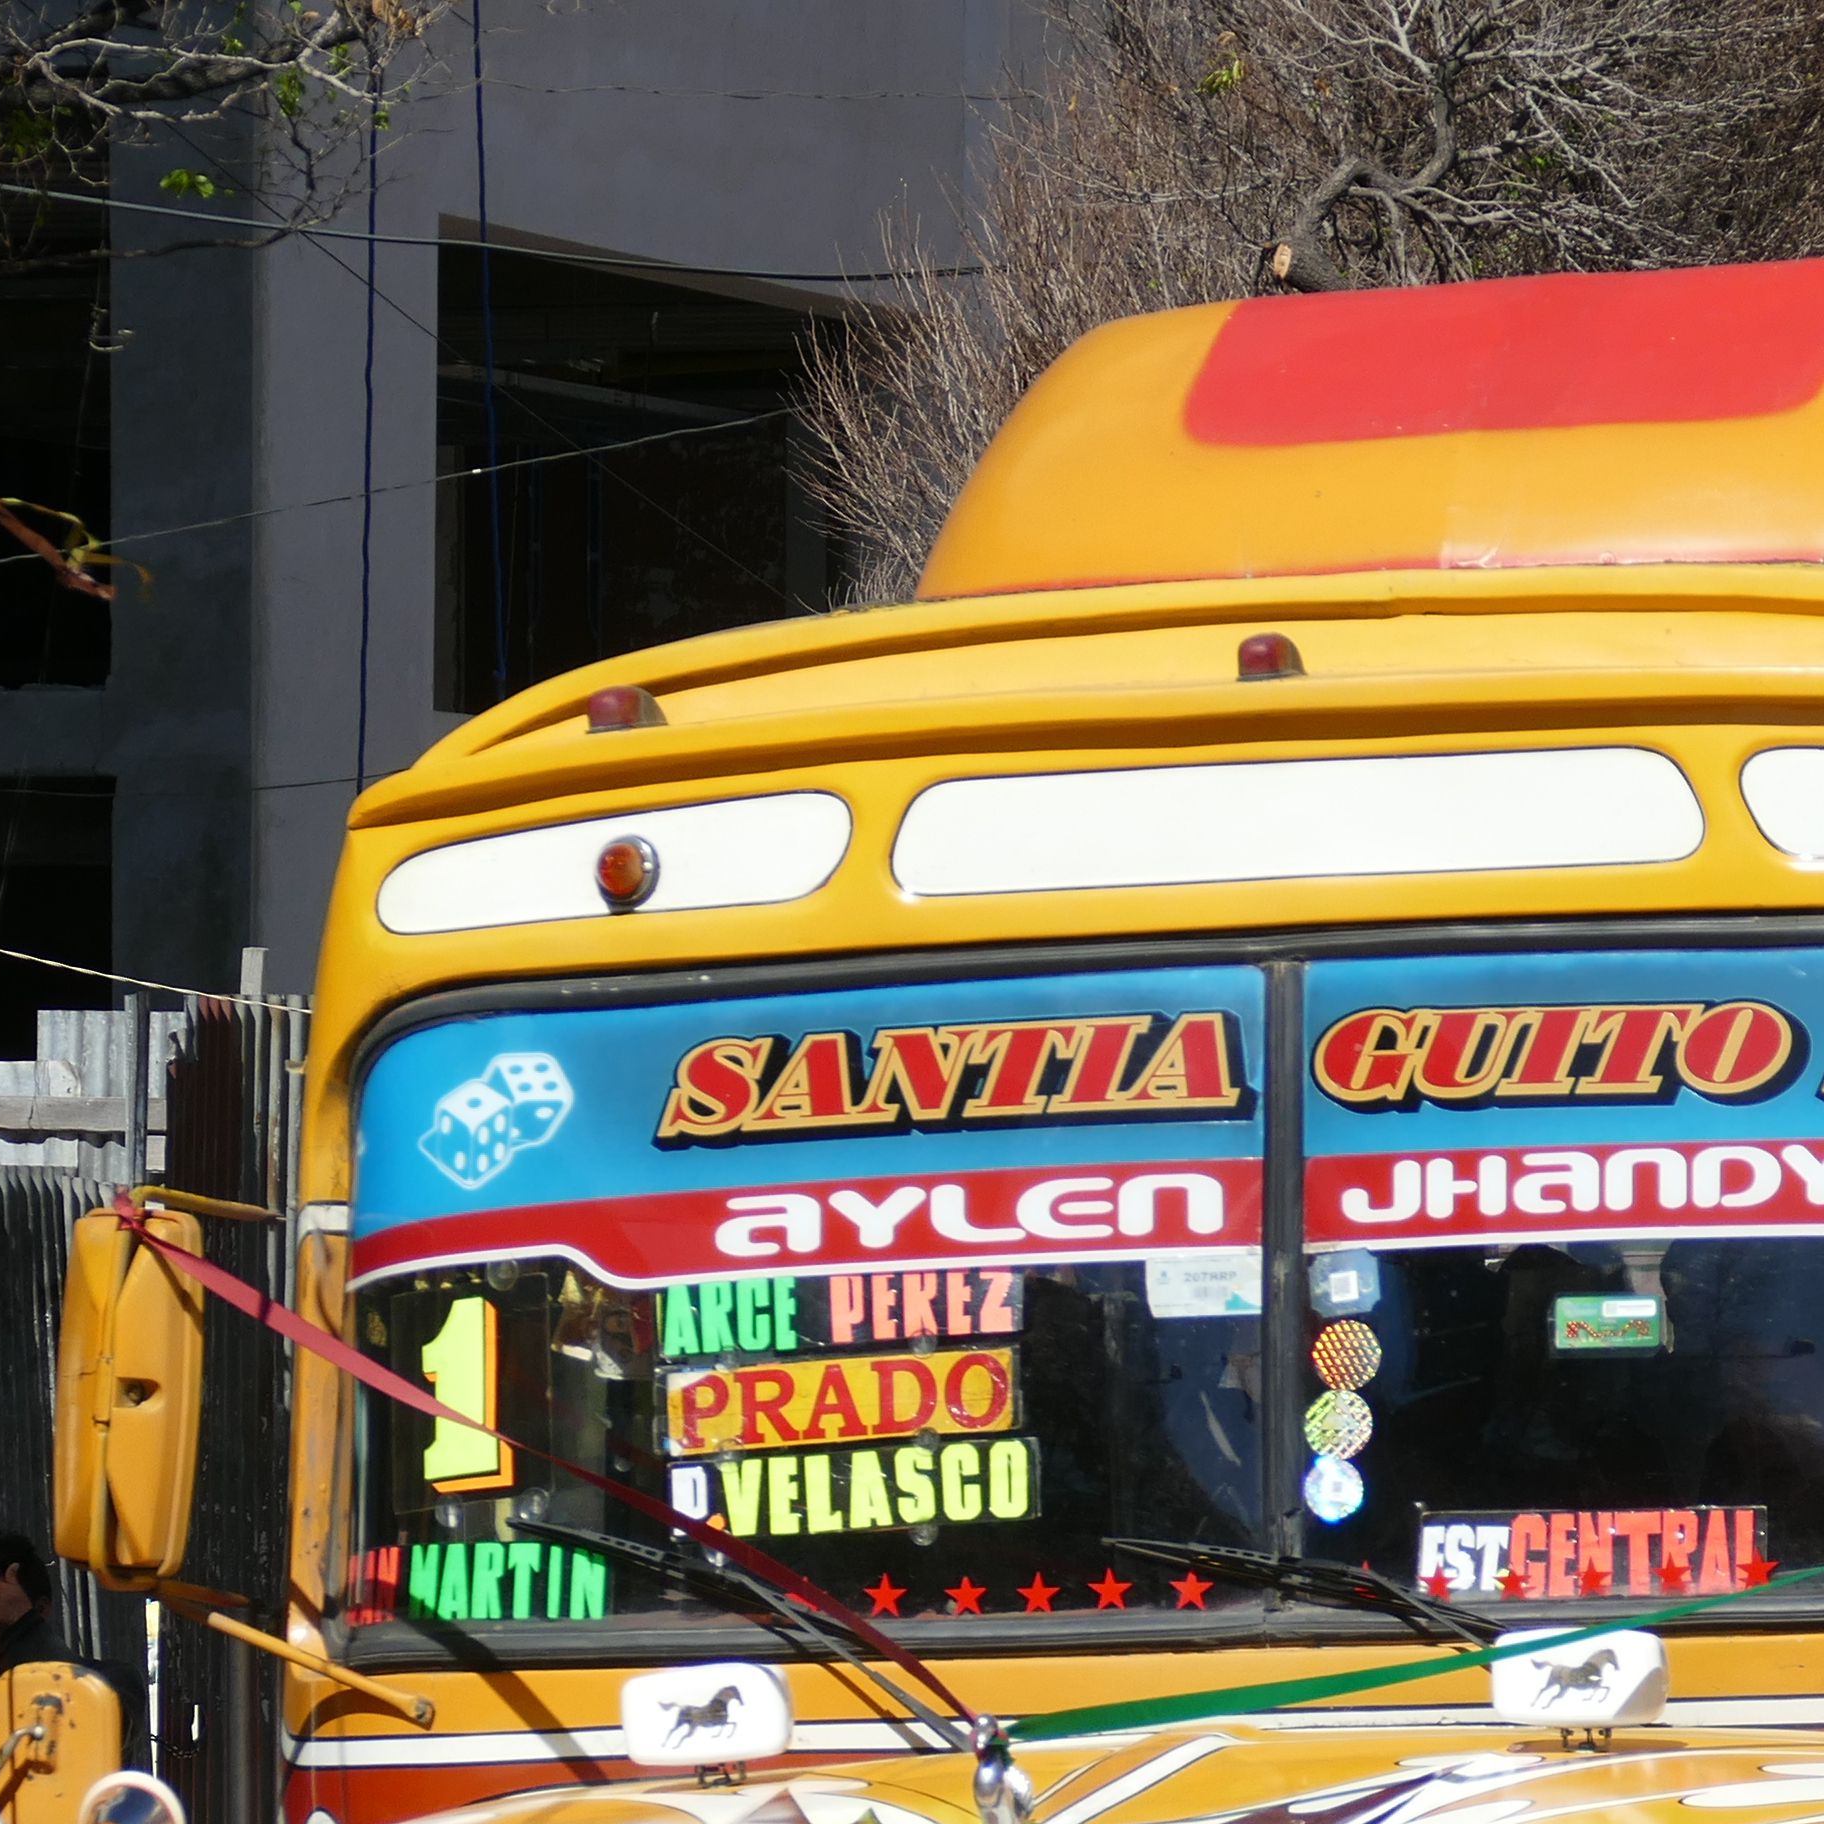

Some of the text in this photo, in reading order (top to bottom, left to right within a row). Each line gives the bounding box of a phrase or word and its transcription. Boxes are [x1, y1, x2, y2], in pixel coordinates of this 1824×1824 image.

[656, 1012, 1248, 1142] SANTIA
[1312, 1000, 1798, 1106] GUITO
[664, 1277, 799, 1356] ARCE
[422, 1296, 514, 1494] 1
[681, 1353, 1008, 1449] PRADO
[408, 1543, 606, 1620] MARTIN
